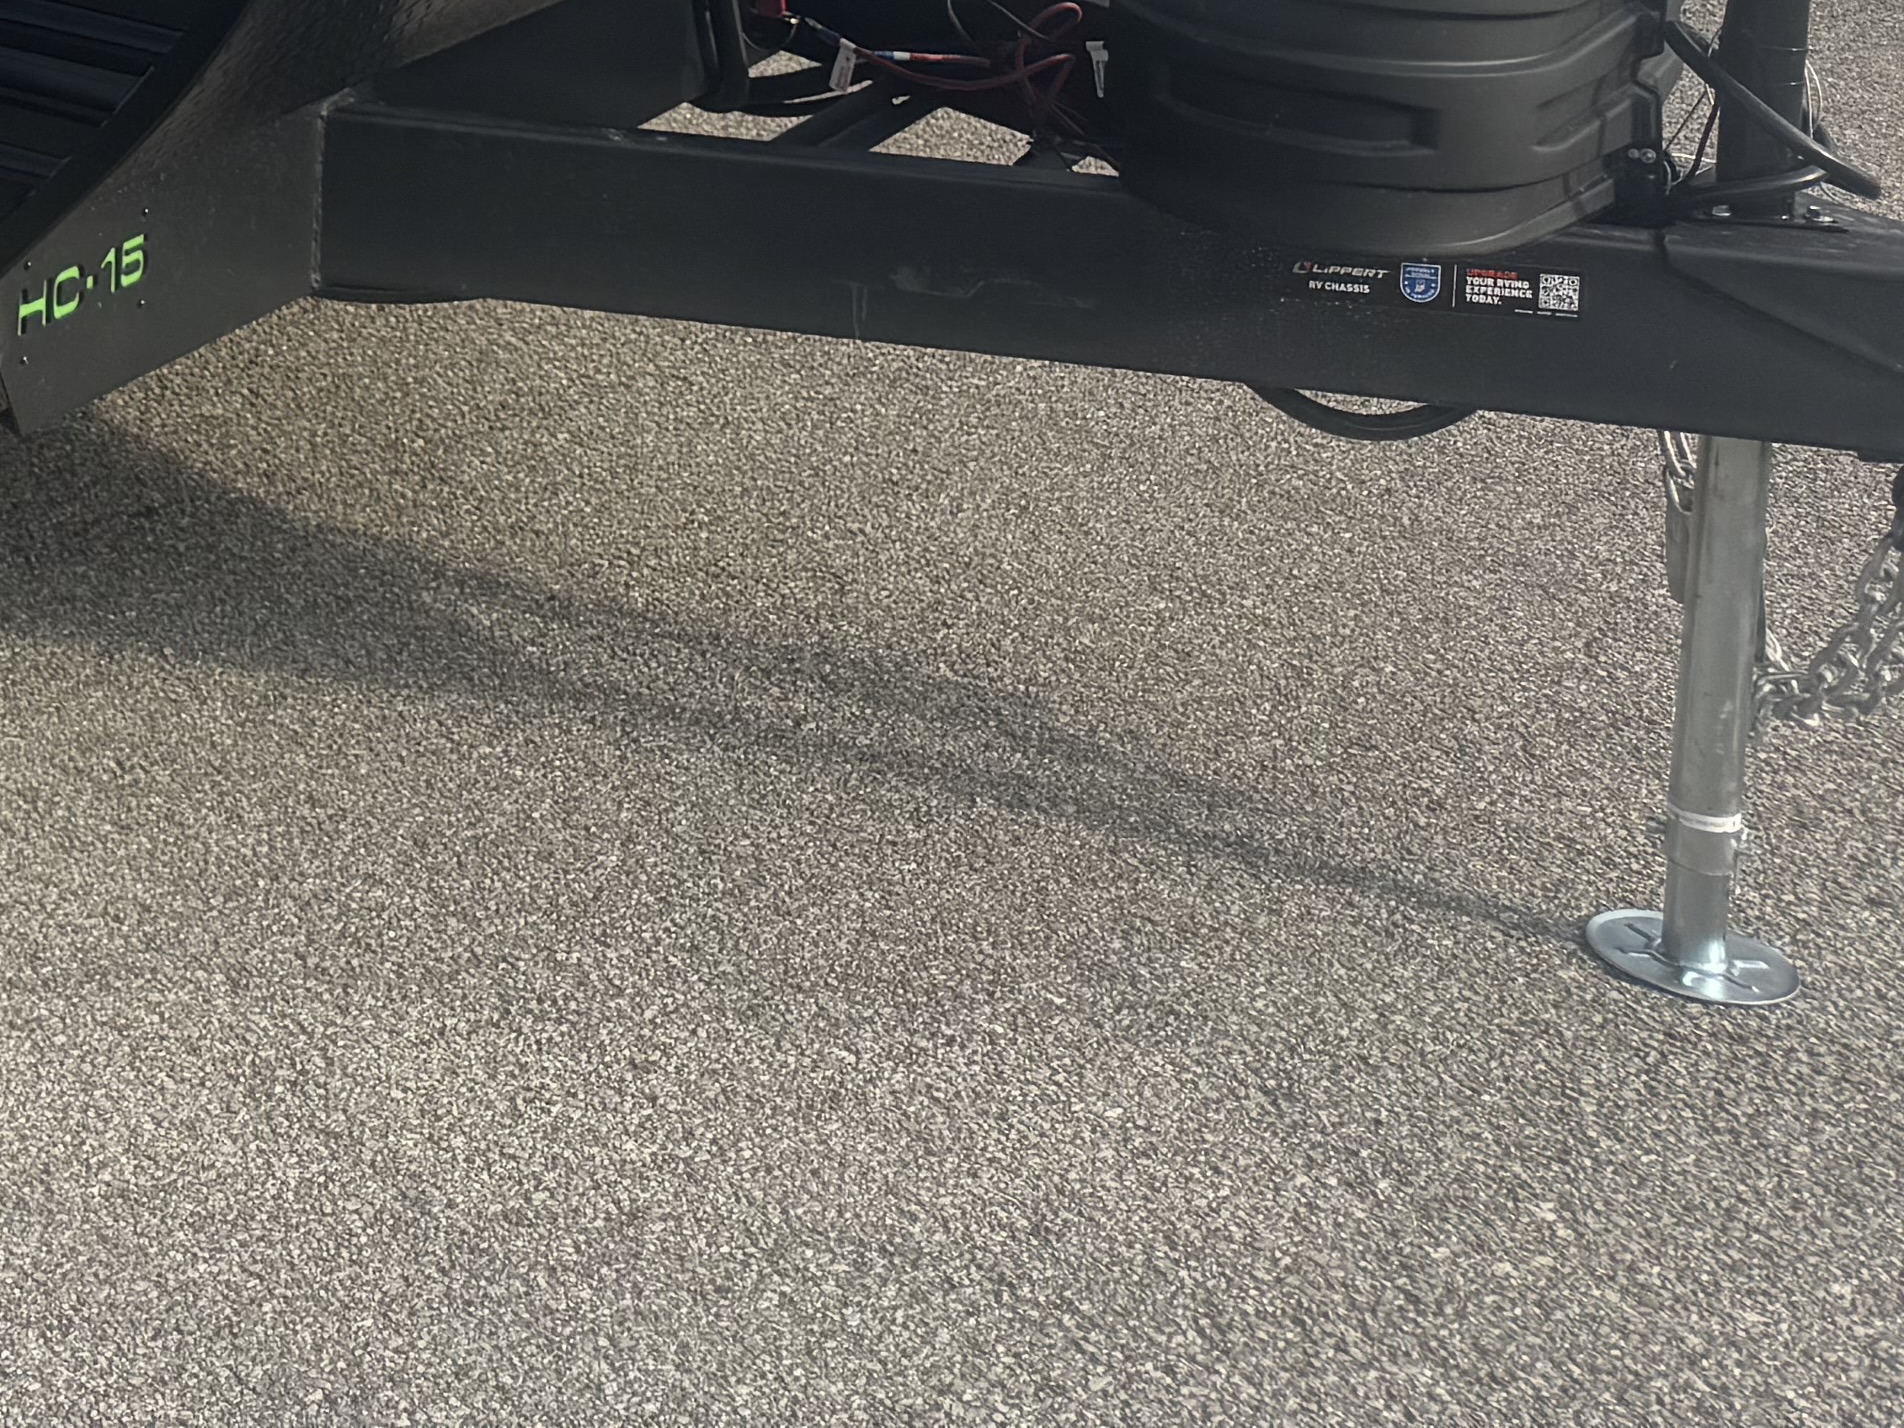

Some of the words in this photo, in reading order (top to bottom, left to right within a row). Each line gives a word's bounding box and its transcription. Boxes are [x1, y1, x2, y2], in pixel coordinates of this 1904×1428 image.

[1324, 281, 1371, 294] CHASSIS
[1465, 276, 1495, 287] YOUR
[1465, 284, 1533, 299] EXPERIENCE
[1465, 293, 1502, 305] TODAY.
